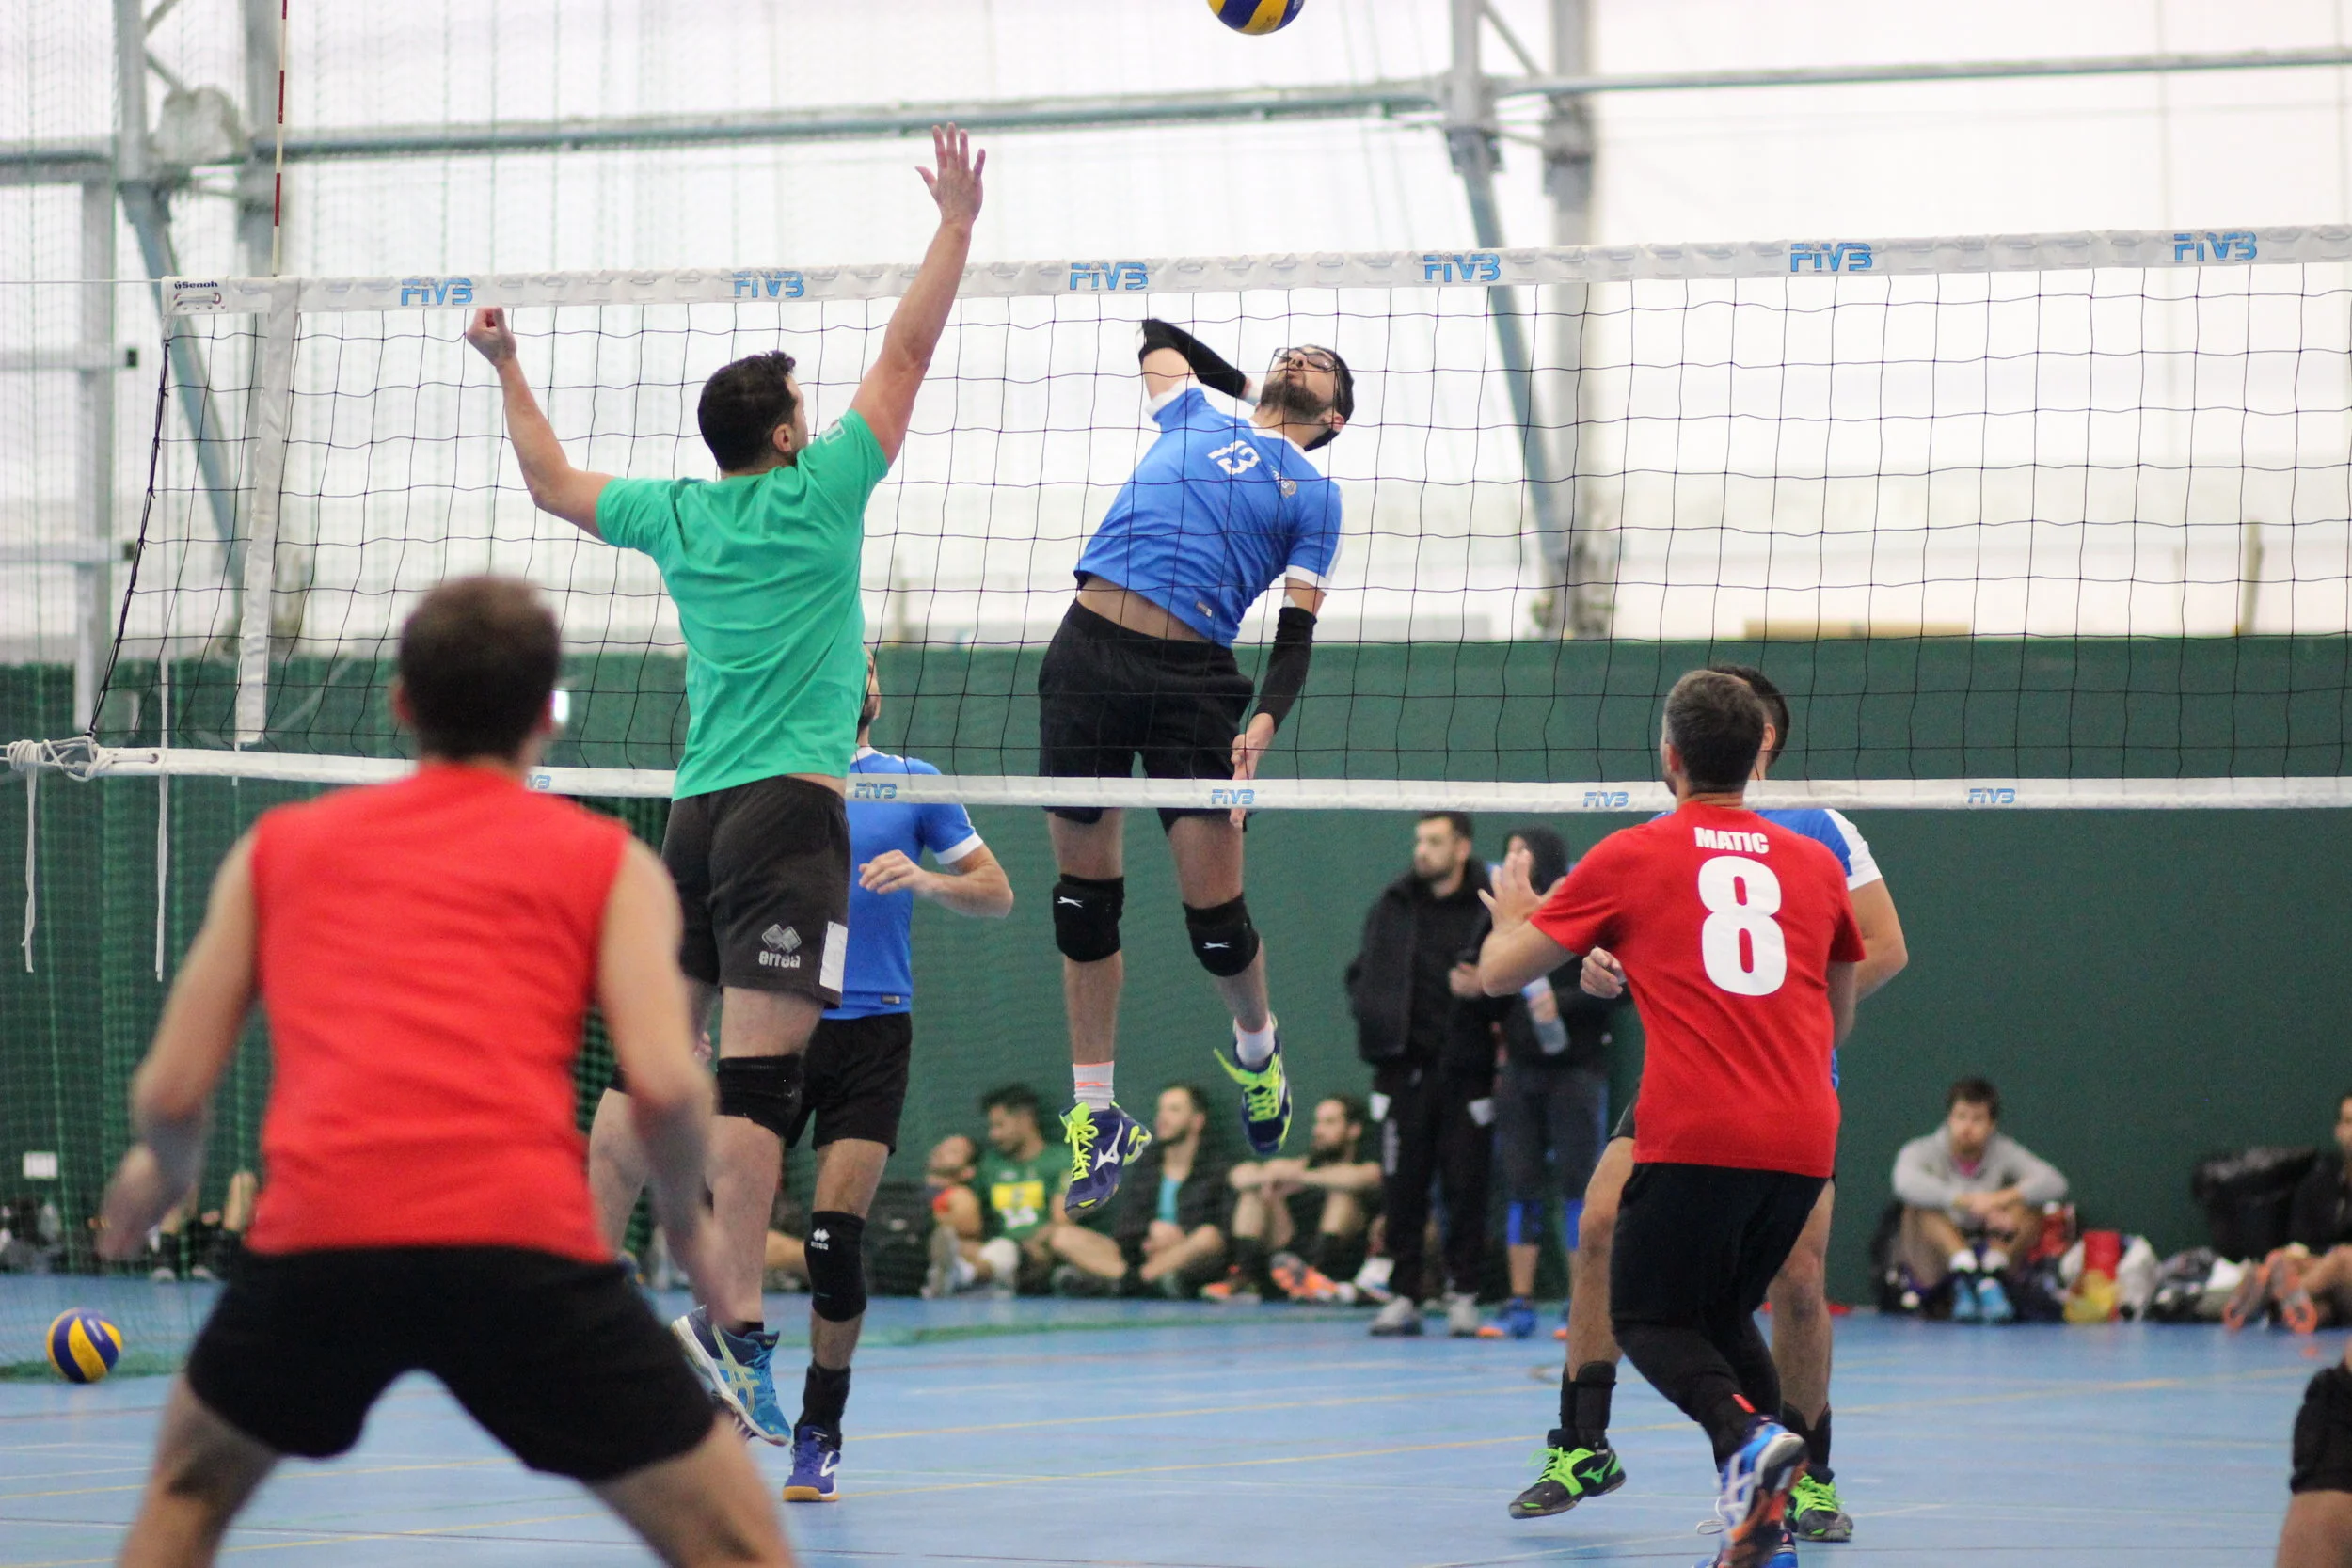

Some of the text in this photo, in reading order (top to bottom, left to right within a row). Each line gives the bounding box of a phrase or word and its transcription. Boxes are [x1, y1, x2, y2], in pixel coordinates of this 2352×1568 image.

[1207, 439, 1261, 475] 13
[1693, 826, 1770, 855] MATIC
[1697, 855, 1788, 997] 8
